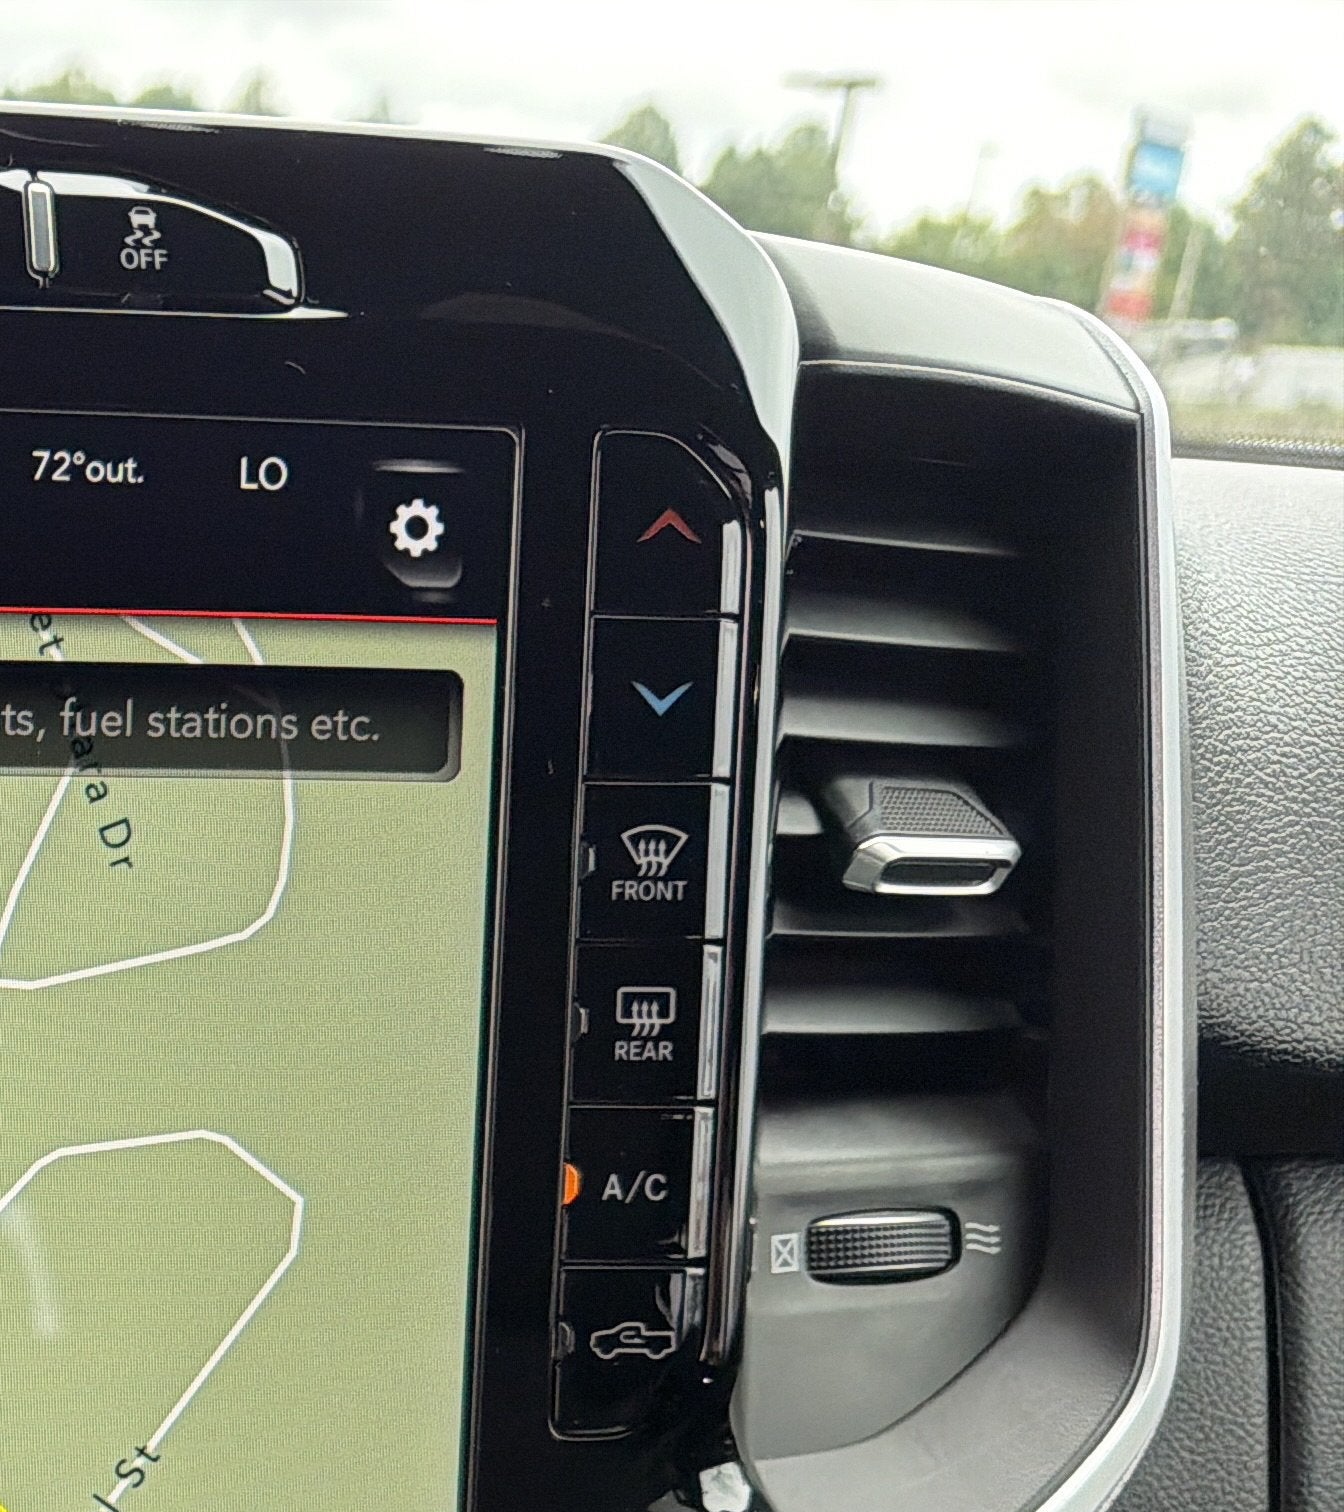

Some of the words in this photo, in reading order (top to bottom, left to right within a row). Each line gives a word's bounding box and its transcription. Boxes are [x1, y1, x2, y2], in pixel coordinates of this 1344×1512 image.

[120, 247, 167, 271] OFF
[240, 457, 289, 491] LO
[60, 697, 133, 738] fuel
[146, 704, 298, 741] stations
[310, 705, 381, 742] etc.
[98, 817, 133, 869] Dr
[611, 880, 687, 901] FRONT
[614, 1040, 673, 1062] REAR
[601, 1172, 668, 1203] A/C
[115, 1444, 161, 1488] St
